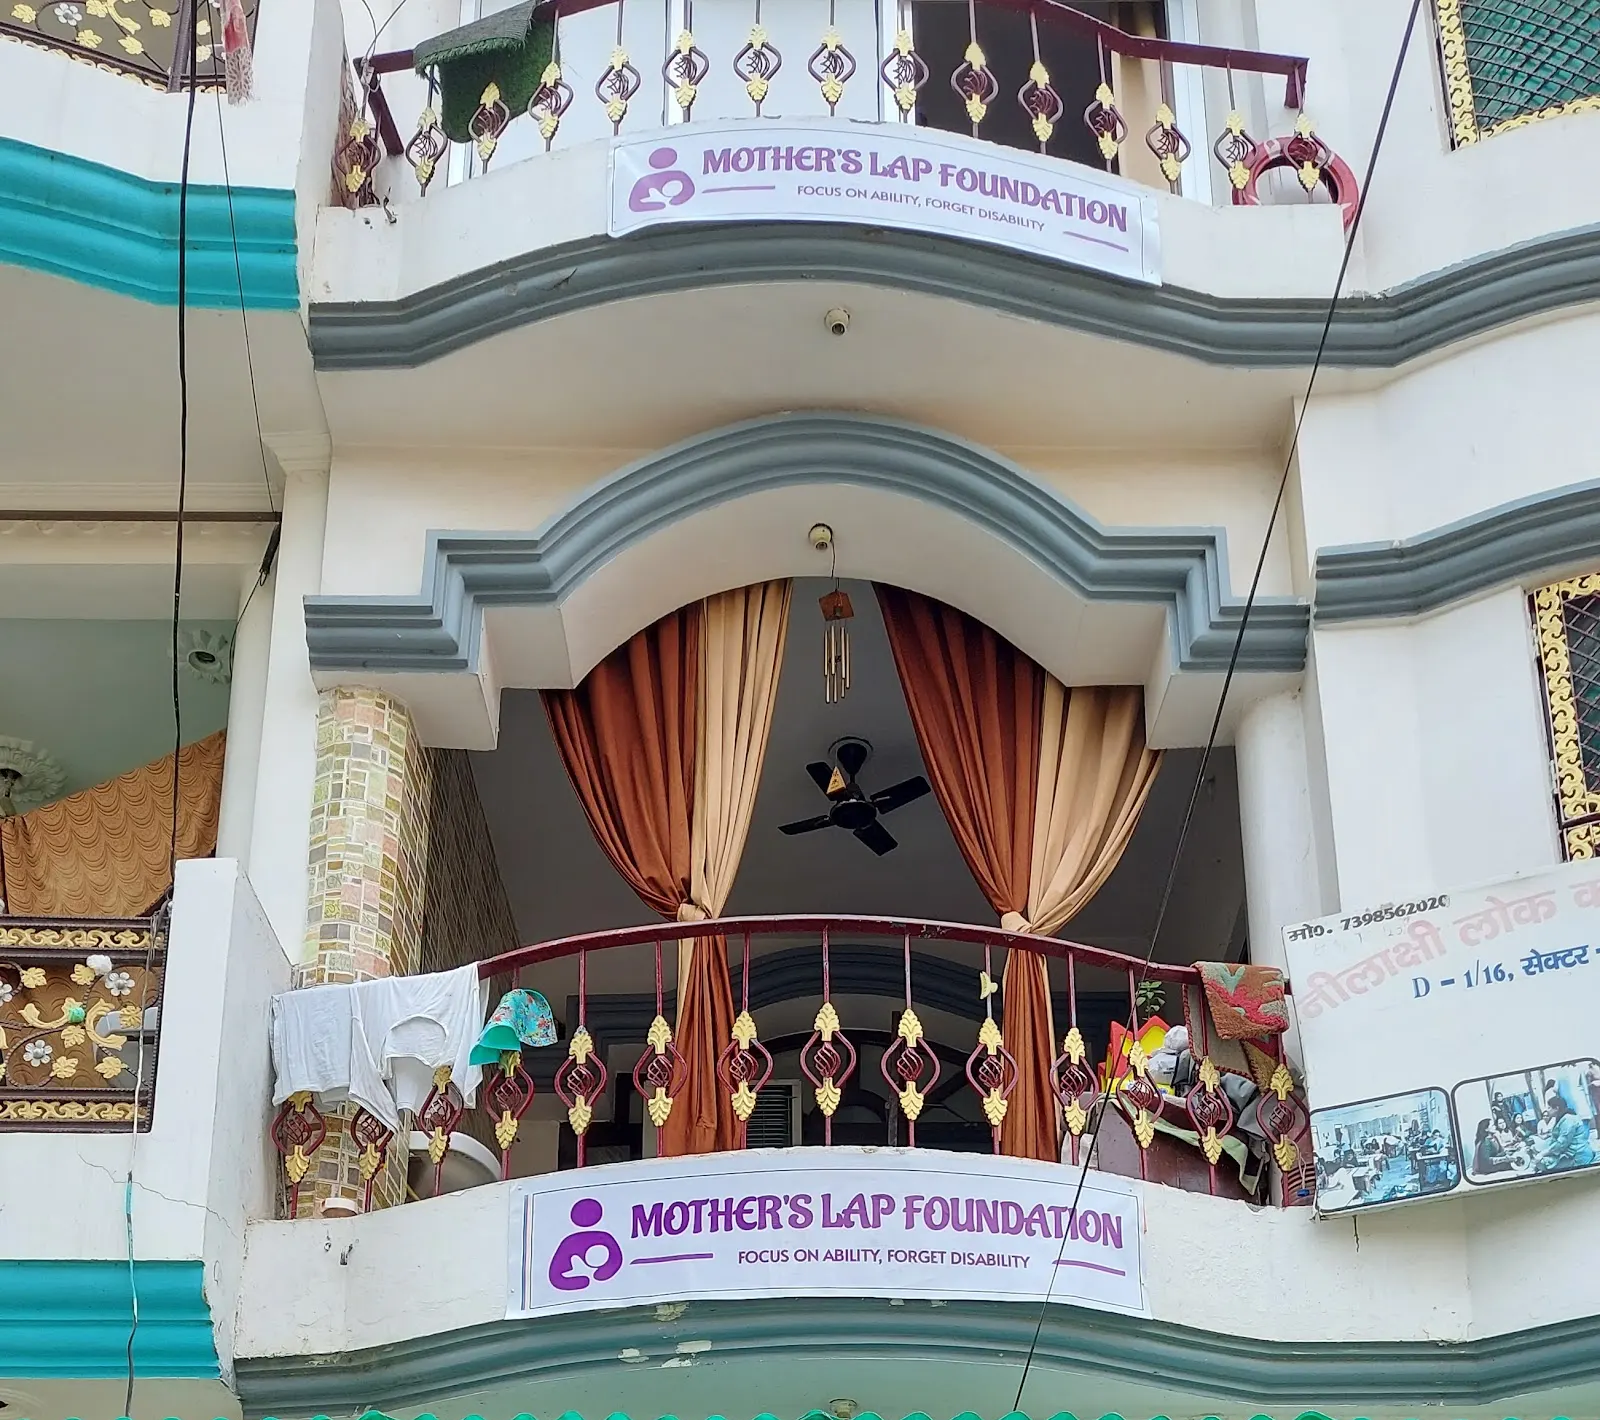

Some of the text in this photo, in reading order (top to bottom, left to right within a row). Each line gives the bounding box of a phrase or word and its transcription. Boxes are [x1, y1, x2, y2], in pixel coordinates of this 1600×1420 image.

[702, 147, 1128, 232] MOTHER'S LAP FOUNDATION
[797, 186, 1046, 232] FOCUS ON ABILITY, FORGET DISABILITY
[1453, 889, 1558, 947] लोक
[1412, 977, 1430, 998] D
[1464, 960, 1514, 988] 1/16,
[1520, 945, 1589, 976] सेक्टर
[630, 1193, 1123, 1249] MOTHER'S LAP FOUNDATION
[738, 1248, 1031, 1270] FOCUS ON ABILITY, FORGET DISABILITY
